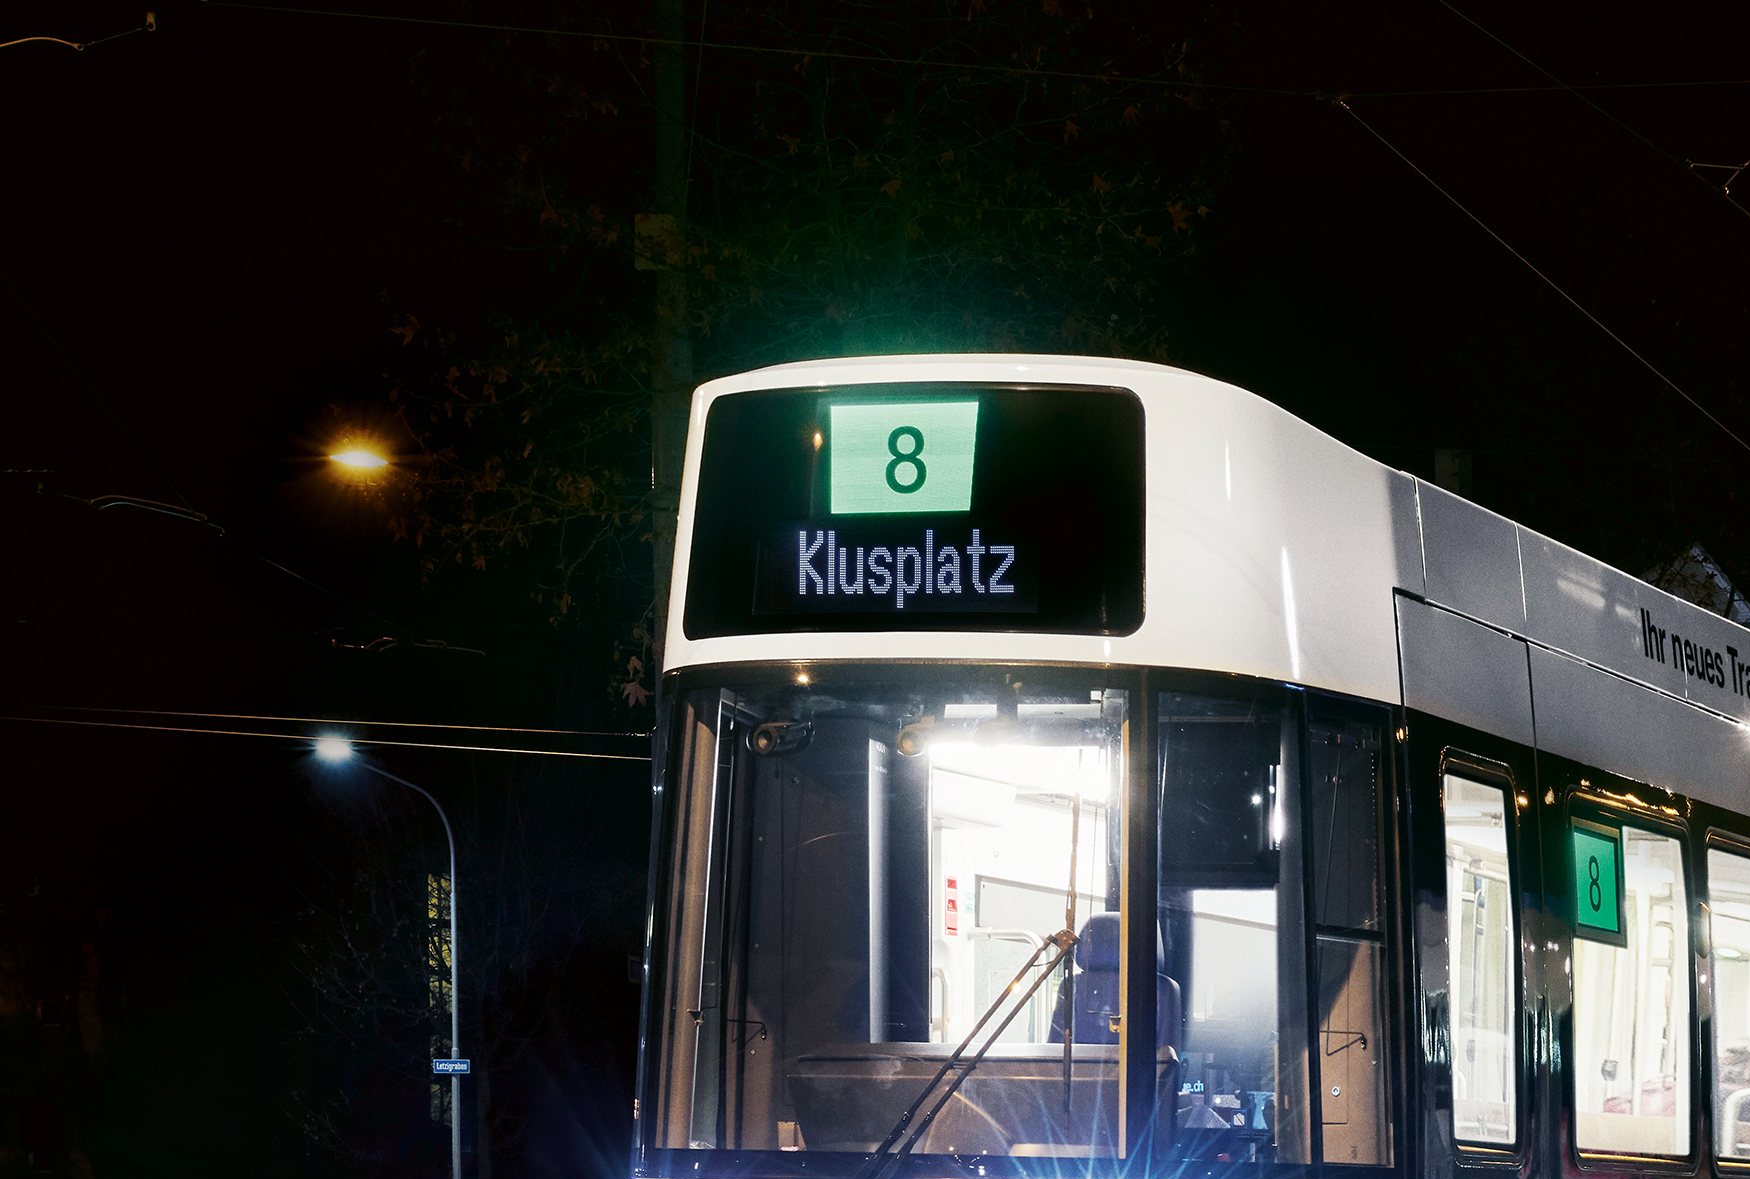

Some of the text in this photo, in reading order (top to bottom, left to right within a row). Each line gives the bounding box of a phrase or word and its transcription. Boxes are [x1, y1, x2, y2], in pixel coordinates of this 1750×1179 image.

[885, 425, 927, 494] 8
[799, 528, 1014, 608] Klusplatz
[1641, 607, 1666, 664] Ihr
[1671, 633, 1725, 688] neues
[1588, 855, 1602, 912] 8
[436, 1062, 468, 1072] Letzigraben
